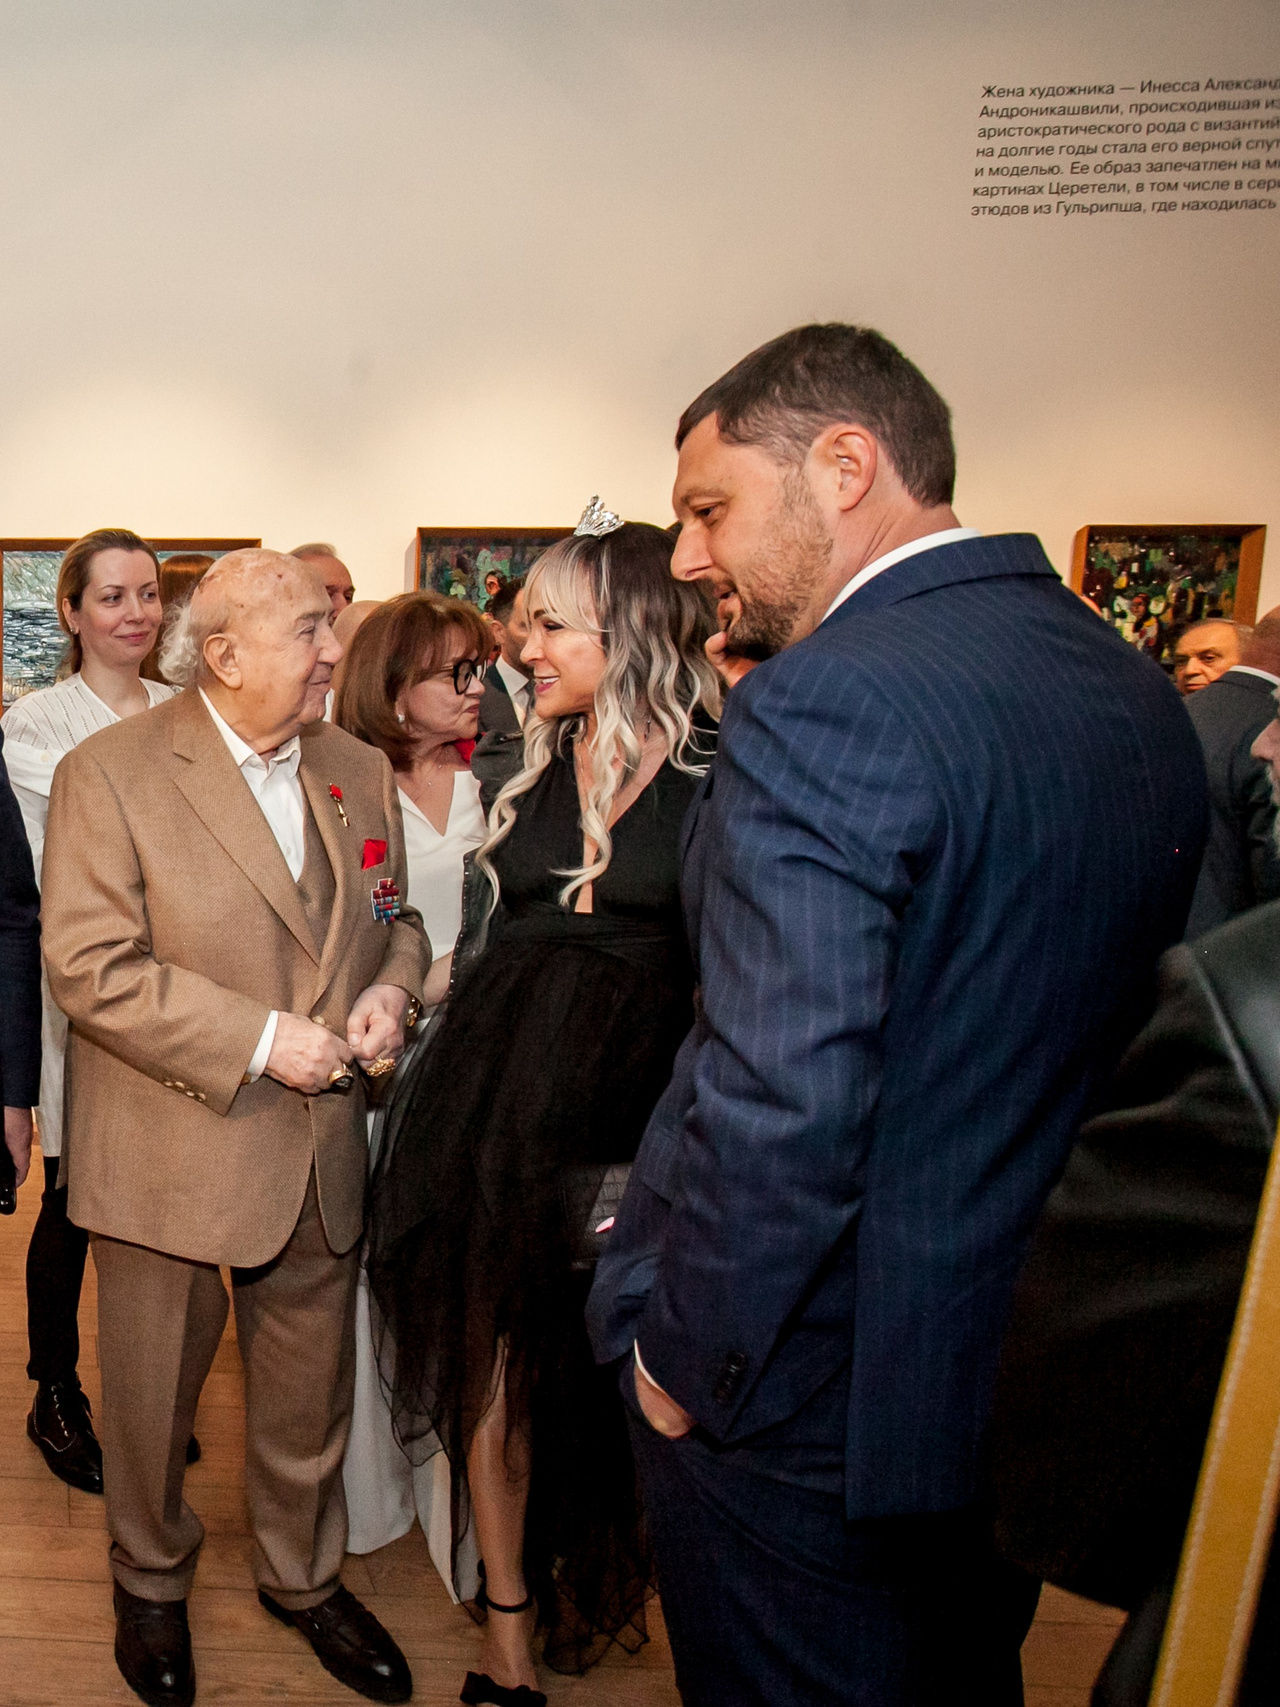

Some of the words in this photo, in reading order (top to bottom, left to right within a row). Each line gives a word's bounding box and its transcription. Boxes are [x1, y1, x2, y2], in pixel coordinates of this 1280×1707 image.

[981, 85, 1024, 98] Жена
[1029, 84, 1115, 100] художника
[1140, 80, 1200, 93] Инесса
[979, 104, 1123, 120] Андроникашвили,
[1129, 99, 1260, 116] происходившая
[978, 123, 1142, 140] аристократического
[1146, 122, 1186, 136] рода
[1190, 121, 1199, 132] с
[976, 147, 994, 157] на
[998, 146, 1054, 158] долгие
[1059, 145, 1098, 156] годы
[1102, 143, 1147, 154] стала
[1151, 142, 1178, 153] его
[1182, 138, 1242, 154] верной
[974, 168, 984, 177] и
[988, 165, 1064, 178] моделью.
[1070, 161, 1090, 174] Ее
[1093, 160, 1141, 176] образ
[1146, 160, 1238, 173] запечатлен
[1242, 159, 1261, 170] на
[1265, 159, 1280, 169] м
[973, 185, 1044, 199] картинах
[1048, 182, 1130, 197] Церетели,
[1136, 182, 1144, 192] в
[1149, 182, 1179, 192] том
[1183, 180, 1230, 191] числе
[1234, 180, 1243, 190] в
[1247, 178, 1280, 192] сер
[971, 205, 1029, 217] этюдов
[1033, 204, 1052, 214] из
[1056, 201, 1146, 217] Гульрипша,
[1152, 201, 1178, 213] где
[1181, 199, 1276, 212] находилась
